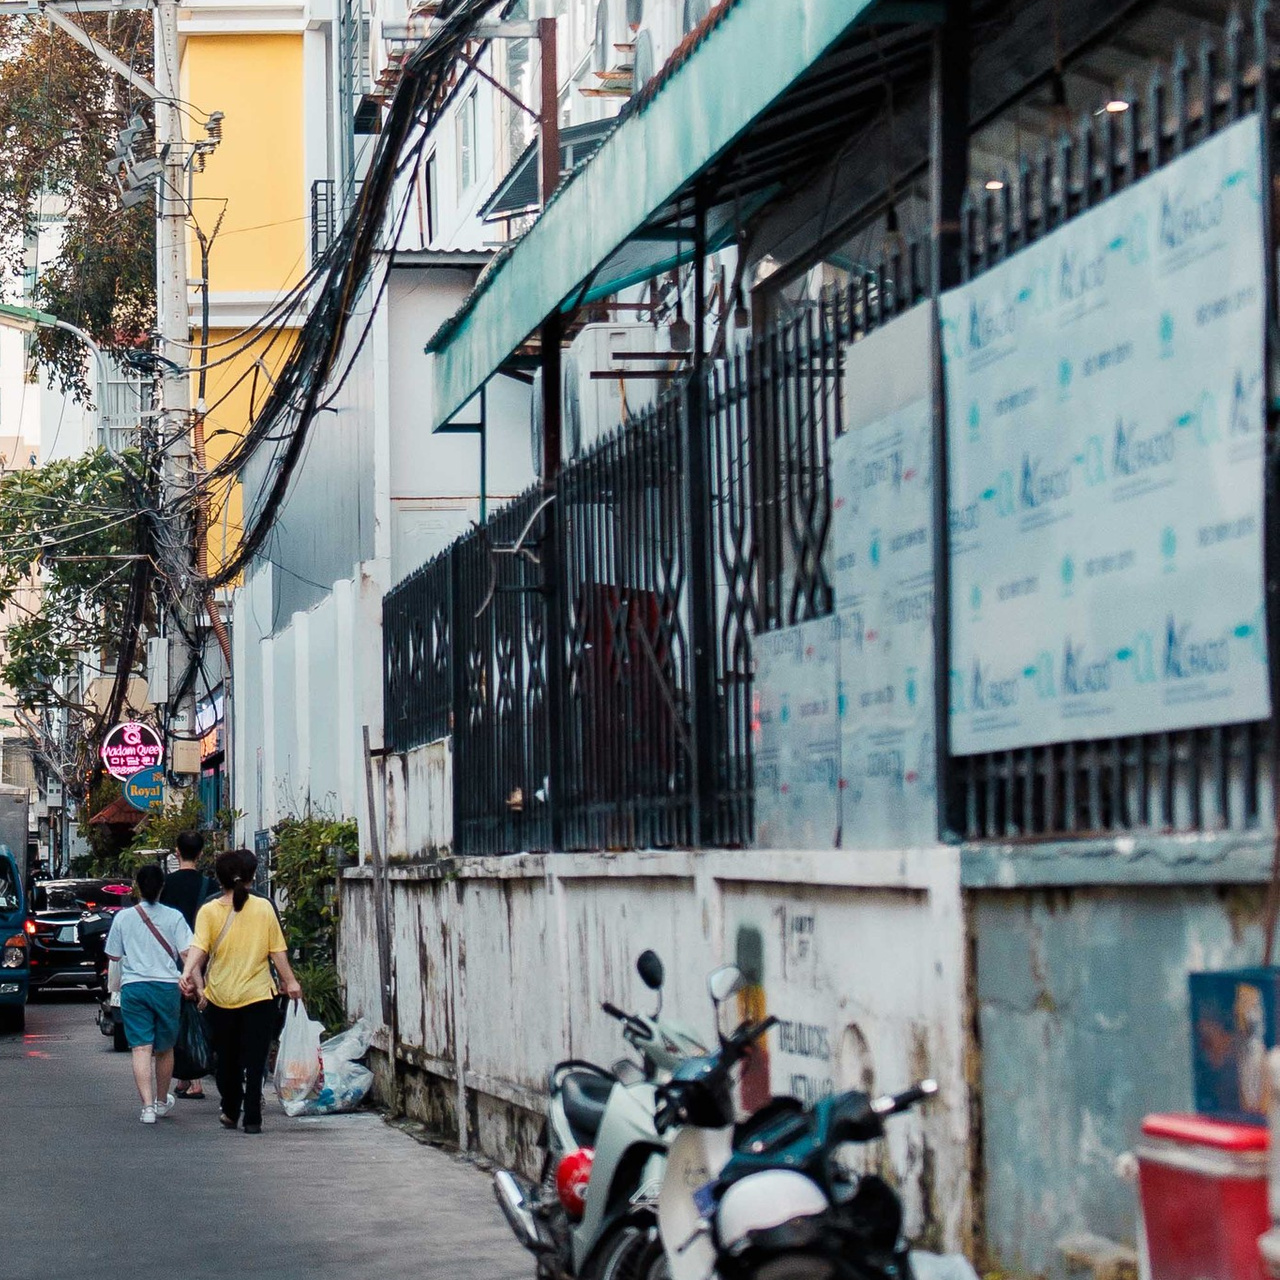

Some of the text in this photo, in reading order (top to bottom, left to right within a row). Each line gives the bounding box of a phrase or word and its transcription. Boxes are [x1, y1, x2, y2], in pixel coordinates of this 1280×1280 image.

[101, 744, 164, 757] Madam Quee
[130, 785, 160, 798] Royal
